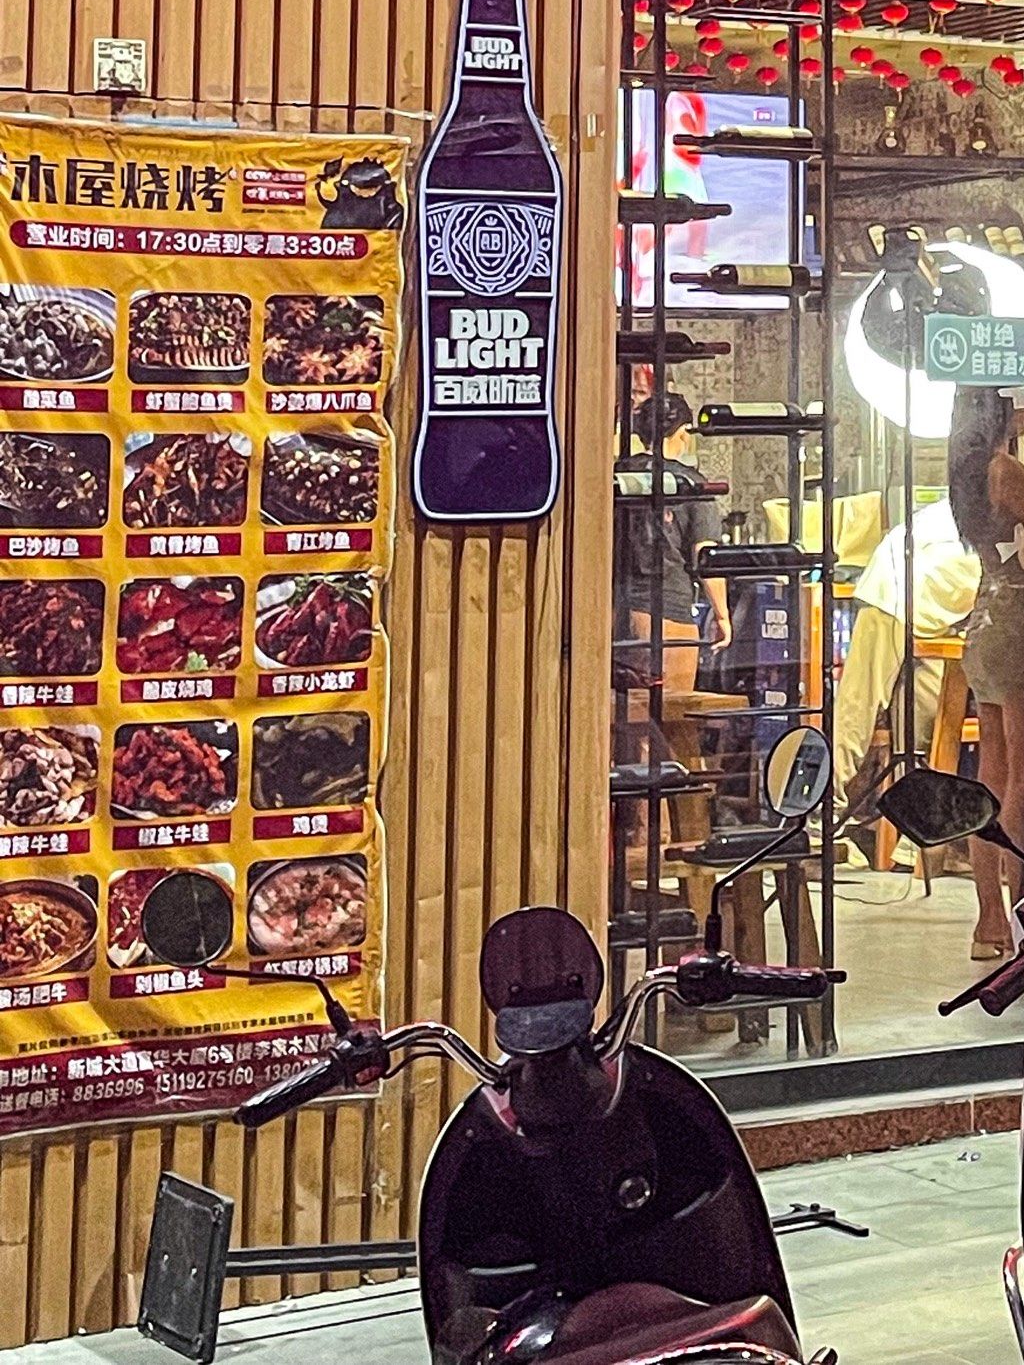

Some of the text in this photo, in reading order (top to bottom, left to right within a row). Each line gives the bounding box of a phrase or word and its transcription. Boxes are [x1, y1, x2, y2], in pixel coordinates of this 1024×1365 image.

[471, 36, 515, 54] BUD
[464, 51, 522, 70] LIGHT
[10, 154, 231, 212] 木屋烧烤
[450, 309, 530, 339] BUD
[970, 322, 1015, 347] 谢绝
[435, 338, 544, 369] LIGHT
[8, 537, 80, 557] 巴沙烤鱼
